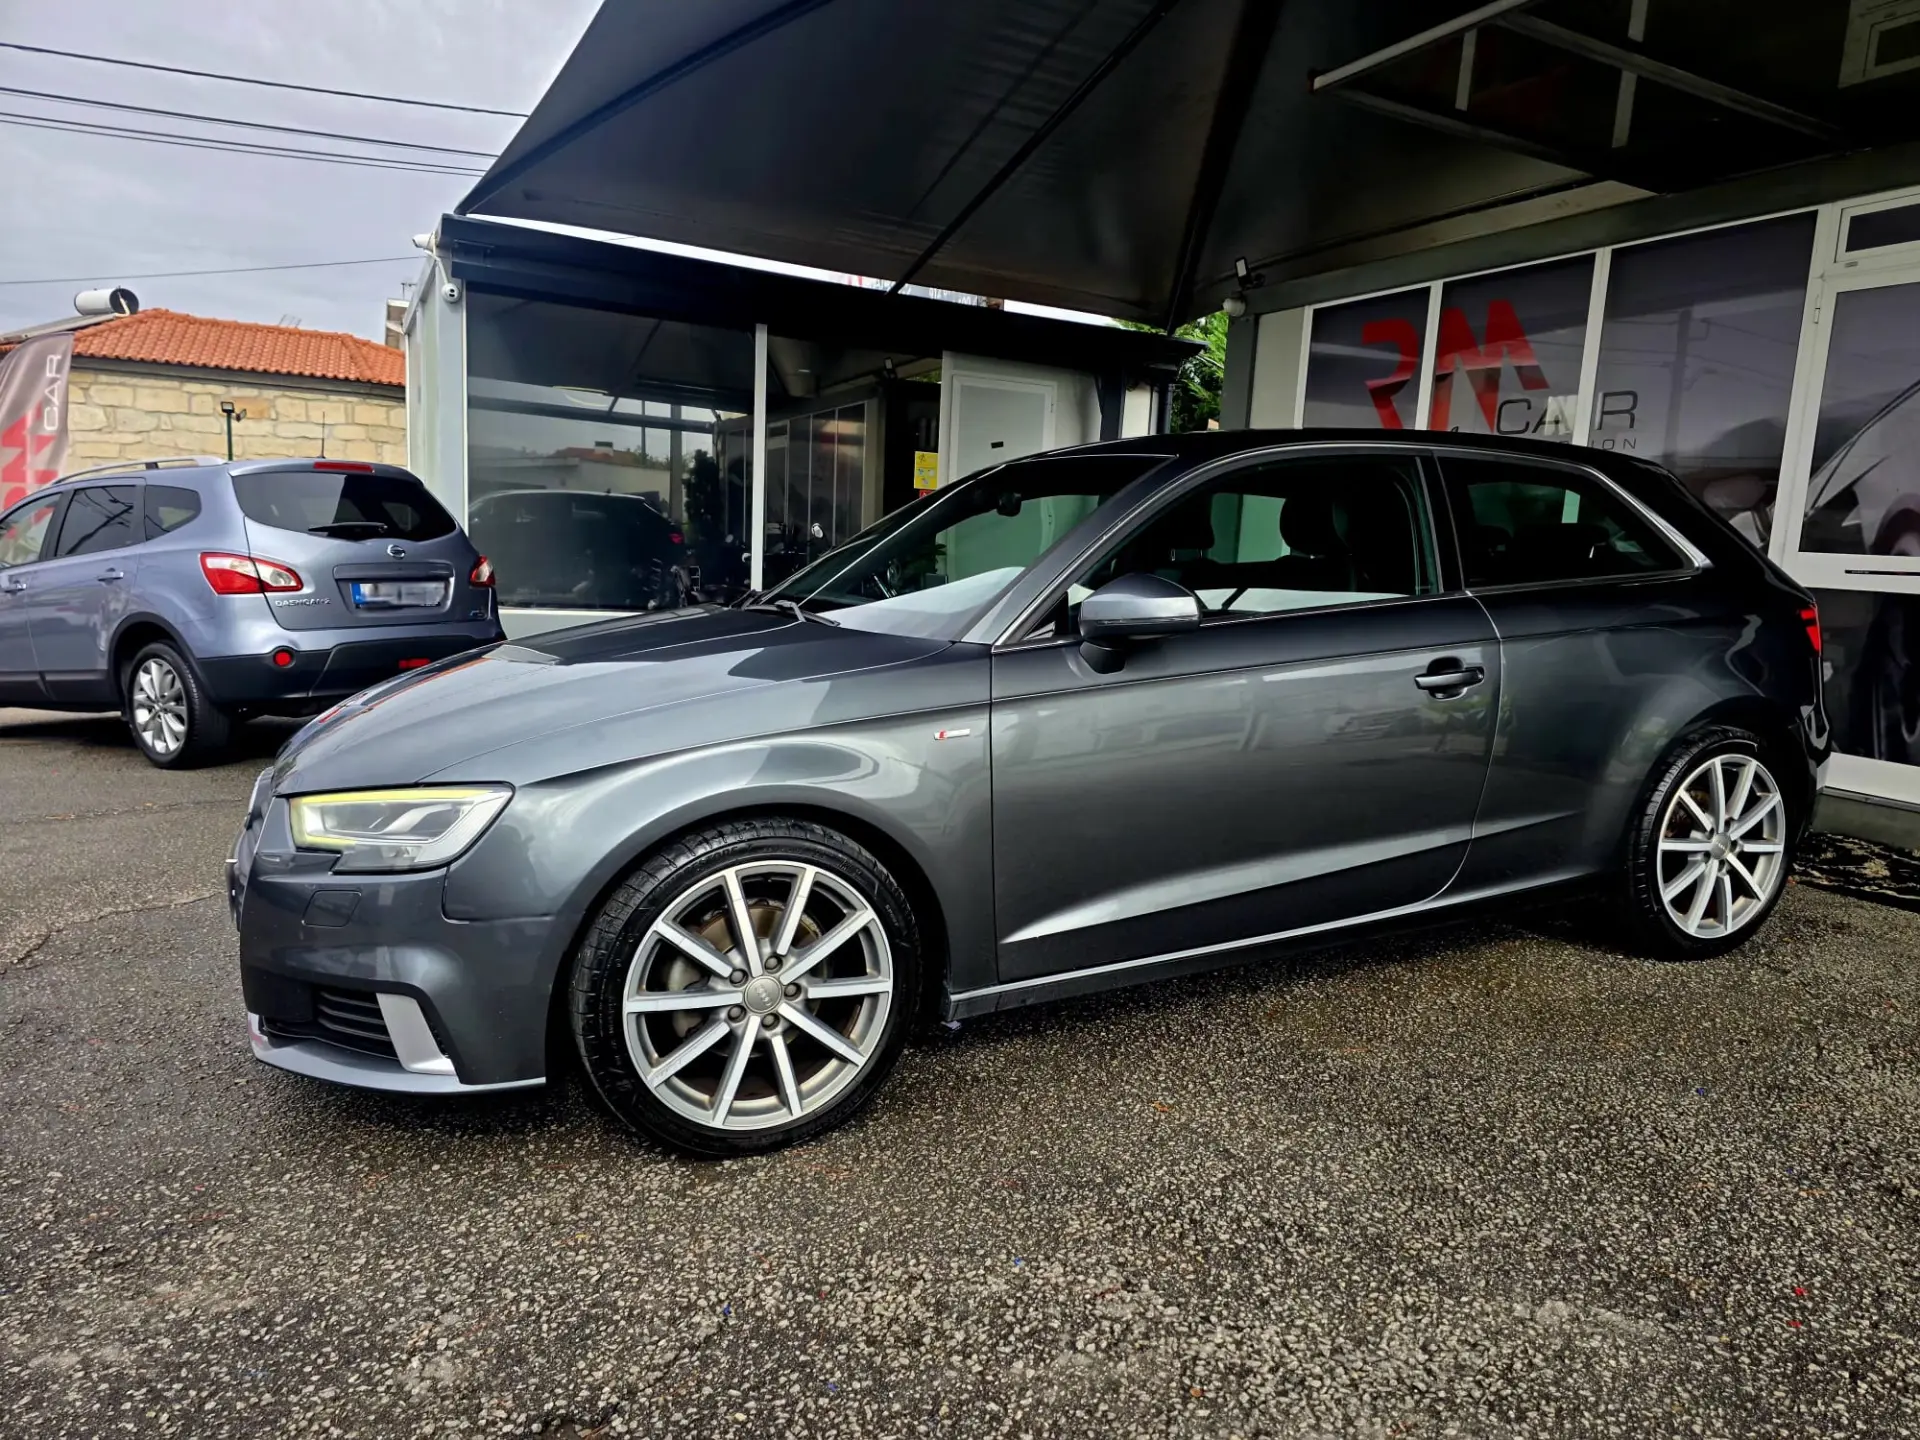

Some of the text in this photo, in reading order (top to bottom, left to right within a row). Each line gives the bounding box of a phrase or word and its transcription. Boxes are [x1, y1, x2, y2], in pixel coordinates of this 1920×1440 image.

[44, 354, 62, 431] CAR
[1362, 298, 1549, 433] RM
[1496, 390, 1638, 435] CAR
